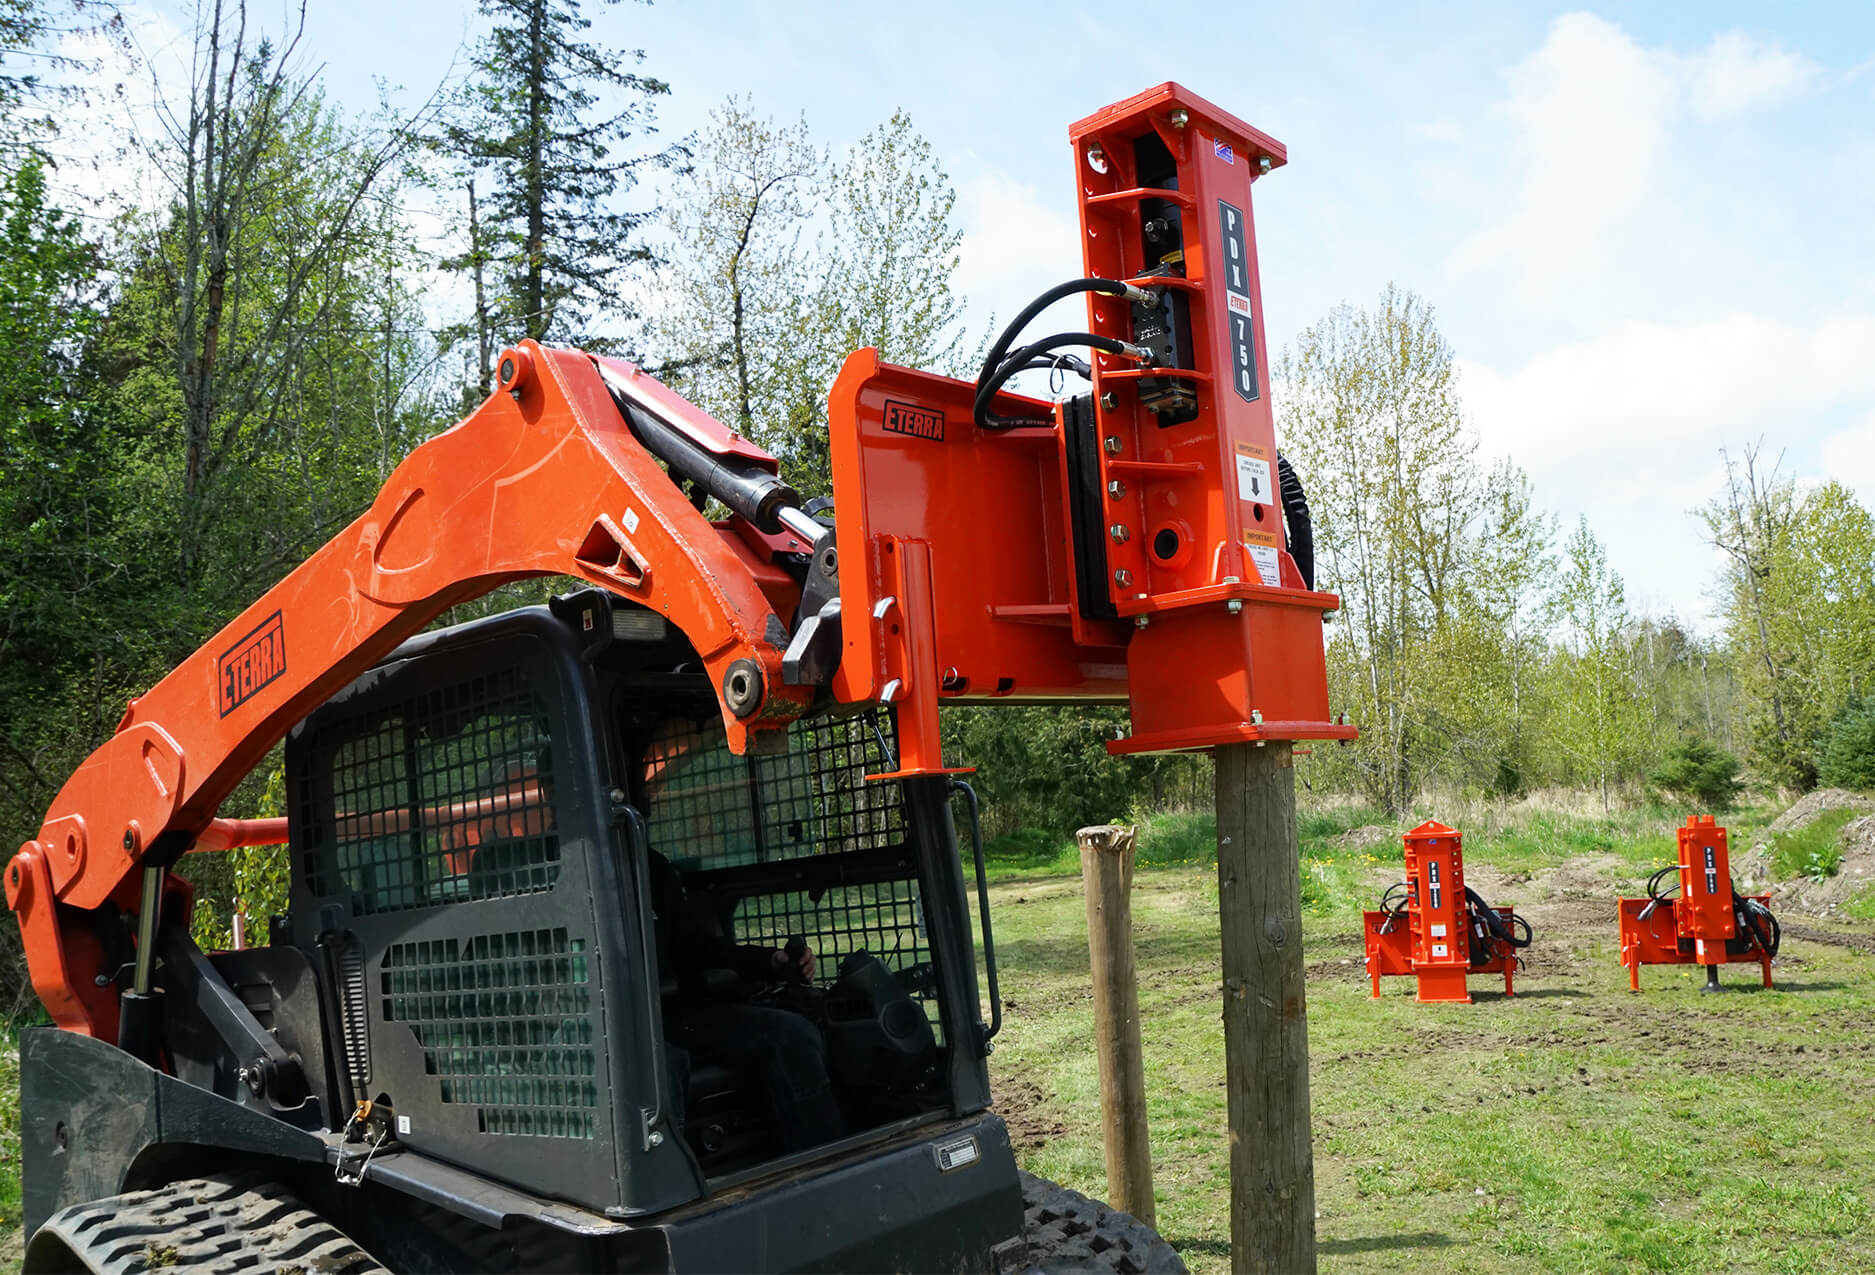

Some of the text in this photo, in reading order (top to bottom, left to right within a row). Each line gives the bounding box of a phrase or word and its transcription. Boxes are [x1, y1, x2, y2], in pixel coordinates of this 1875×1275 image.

[1226, 208, 1242, 289] PDX
[1236, 318, 1251, 393] 750
[883, 401, 944, 440] ETERRA
[219, 614, 286, 714] ETERRA
